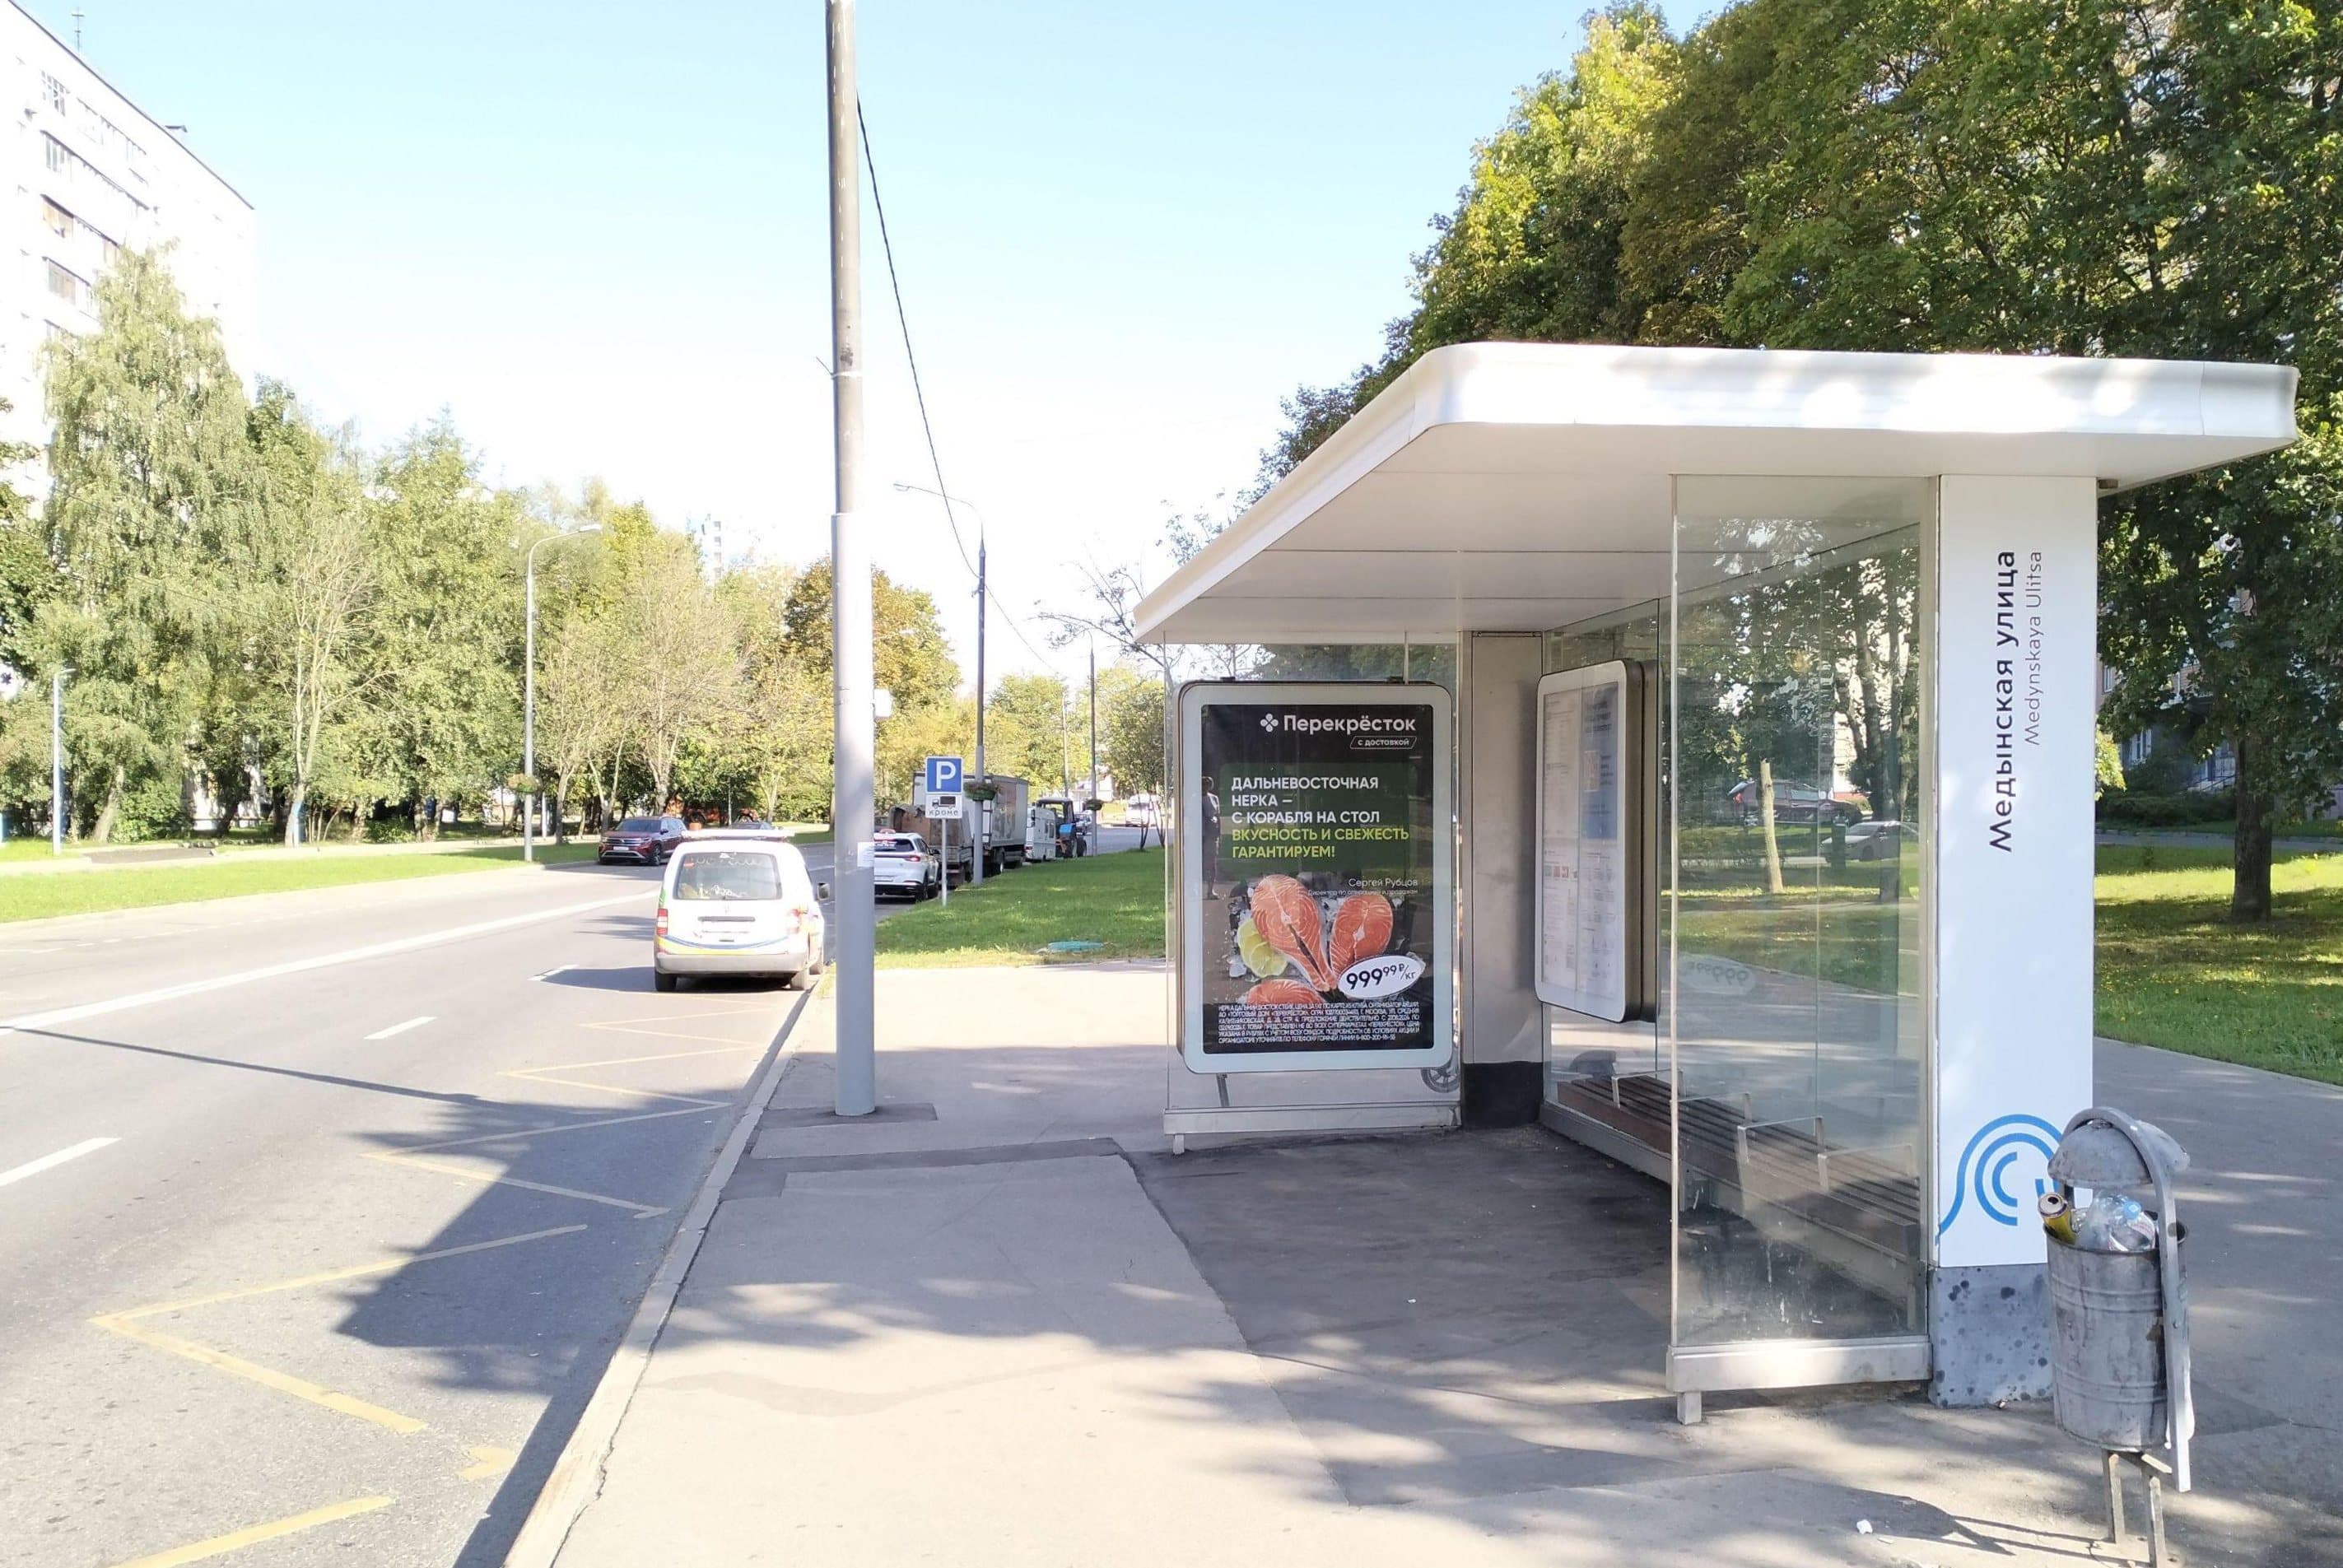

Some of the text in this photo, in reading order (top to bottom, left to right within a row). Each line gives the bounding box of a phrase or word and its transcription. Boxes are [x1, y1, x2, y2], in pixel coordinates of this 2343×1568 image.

[2024, 551, 2044, 745] Medynskaya Ulitsa
[1989, 551, 2019, 852] Медынская улица
[1283, 714, 1416, 735] Перекрёсток
[1364, 738, 1409, 747] доставкой
[1231, 777, 1378, 790] ДАЛЬНЕВОСТОЧНАЯ
[1232, 794, 1278, 807] НЕРКА
[1232, 811, 1380, 823] С КОРАБЛЯ НА СТОЛ
[1232, 827, 1409, 841] ВКУСНОСТЬ И СВЕЖЕСТЬ
[1232, 845, 1335, 858] ГАРАНТИРУЕМ!
[1349, 877, 1418, 889] Сергей Рубцов
[1346, 968, 1383, 990] 999
[1383, 965, 1397, 977] 99
